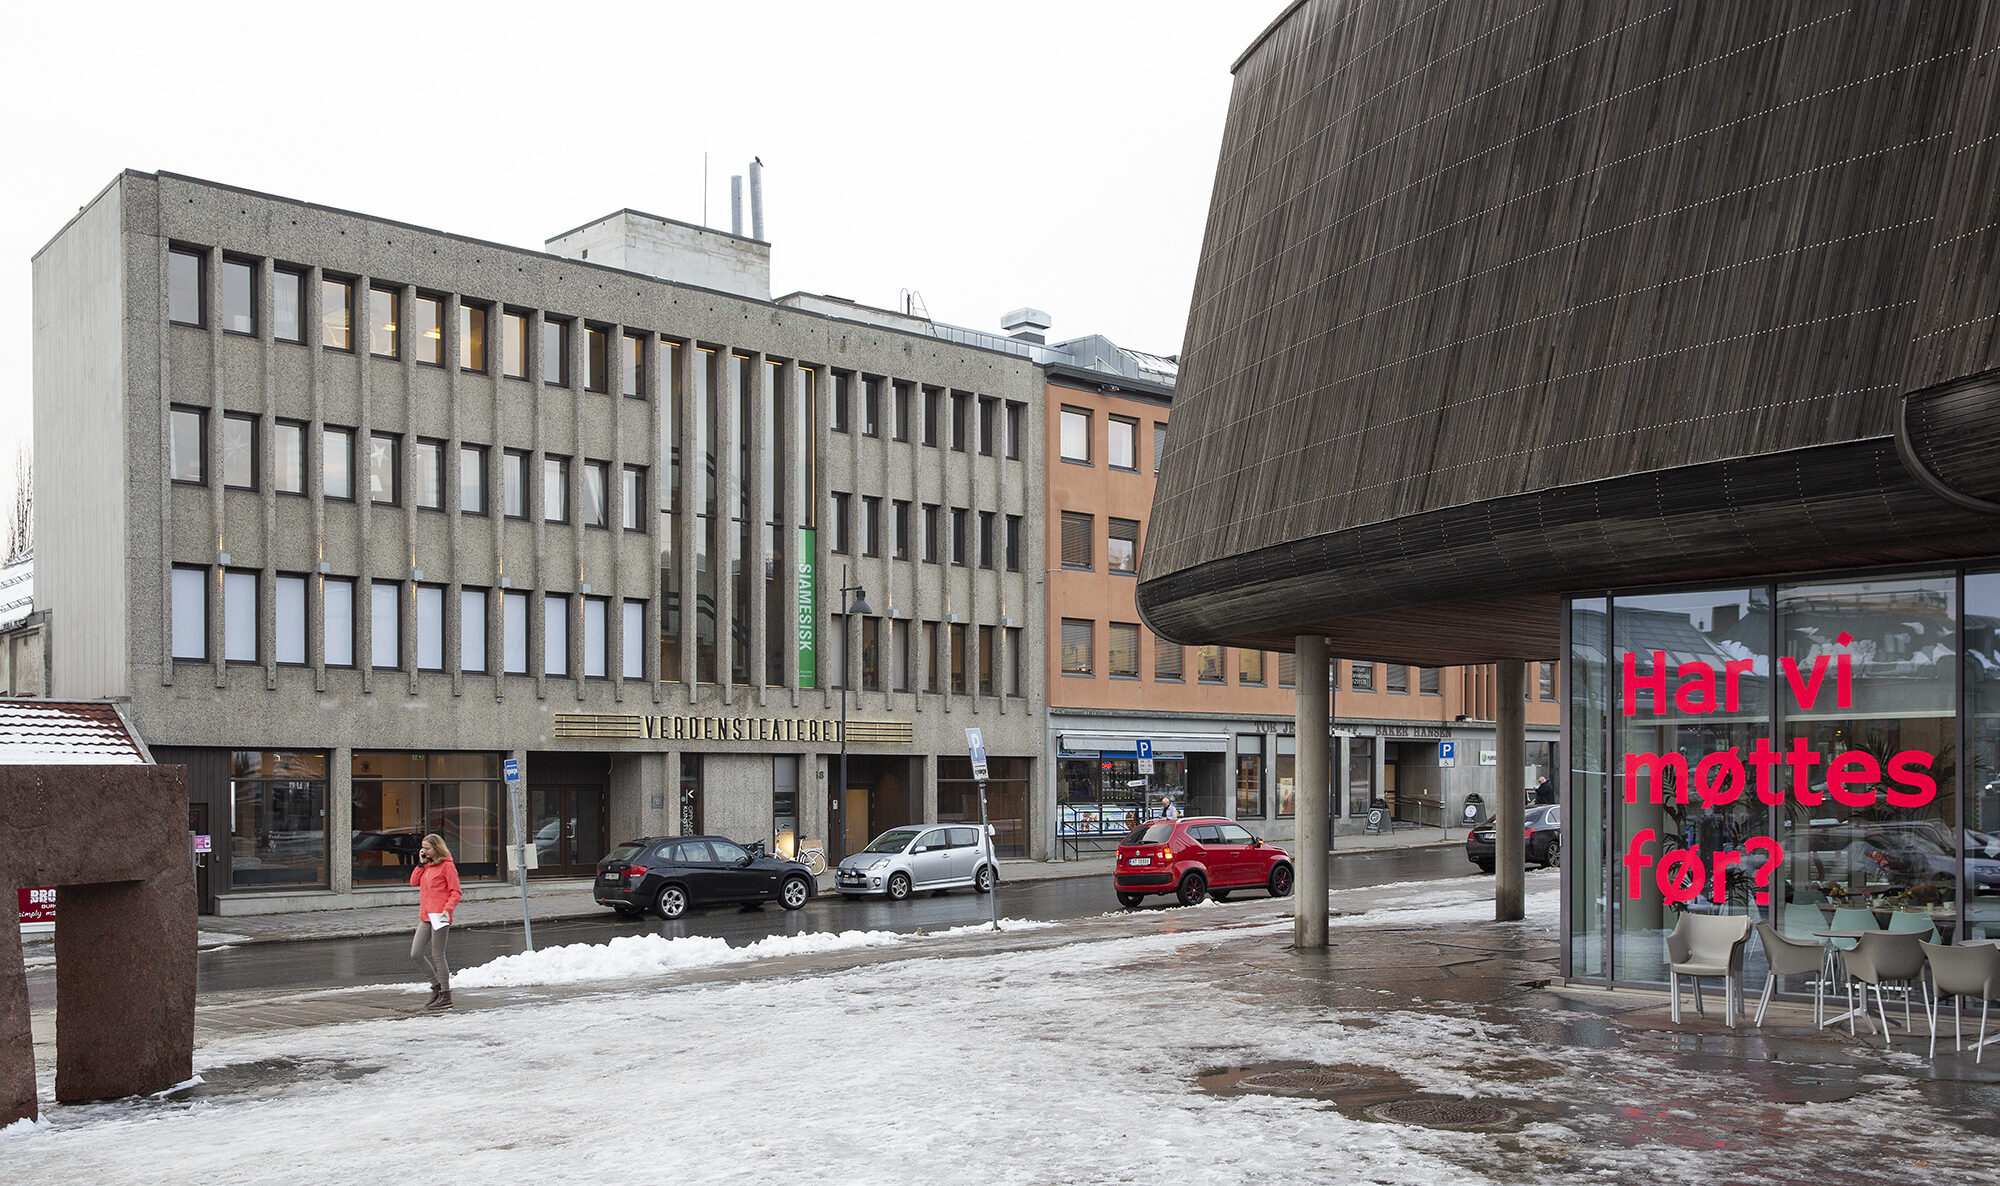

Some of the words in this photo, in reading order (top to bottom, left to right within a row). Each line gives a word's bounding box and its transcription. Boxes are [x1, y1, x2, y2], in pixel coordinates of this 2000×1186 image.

[799, 563, 812, 651] SIAMESISK
[1624, 650, 1754, 716] Har
[1780, 630, 1852, 709] vi
[645, 716, 842, 742] VERDENSTEATERET
[1255, 721, 1277, 733] TOR
[1374, 726, 1409, 737] BAKER
[1413, 726, 1452, 738] HANSEN
[970, 733, 981, 759] P
[1140, 742, 1149, 757] P
[1443, 744, 1452, 757] P
[1625, 737, 1938, 810] møttes
[1624, 829, 1785, 906] før?
